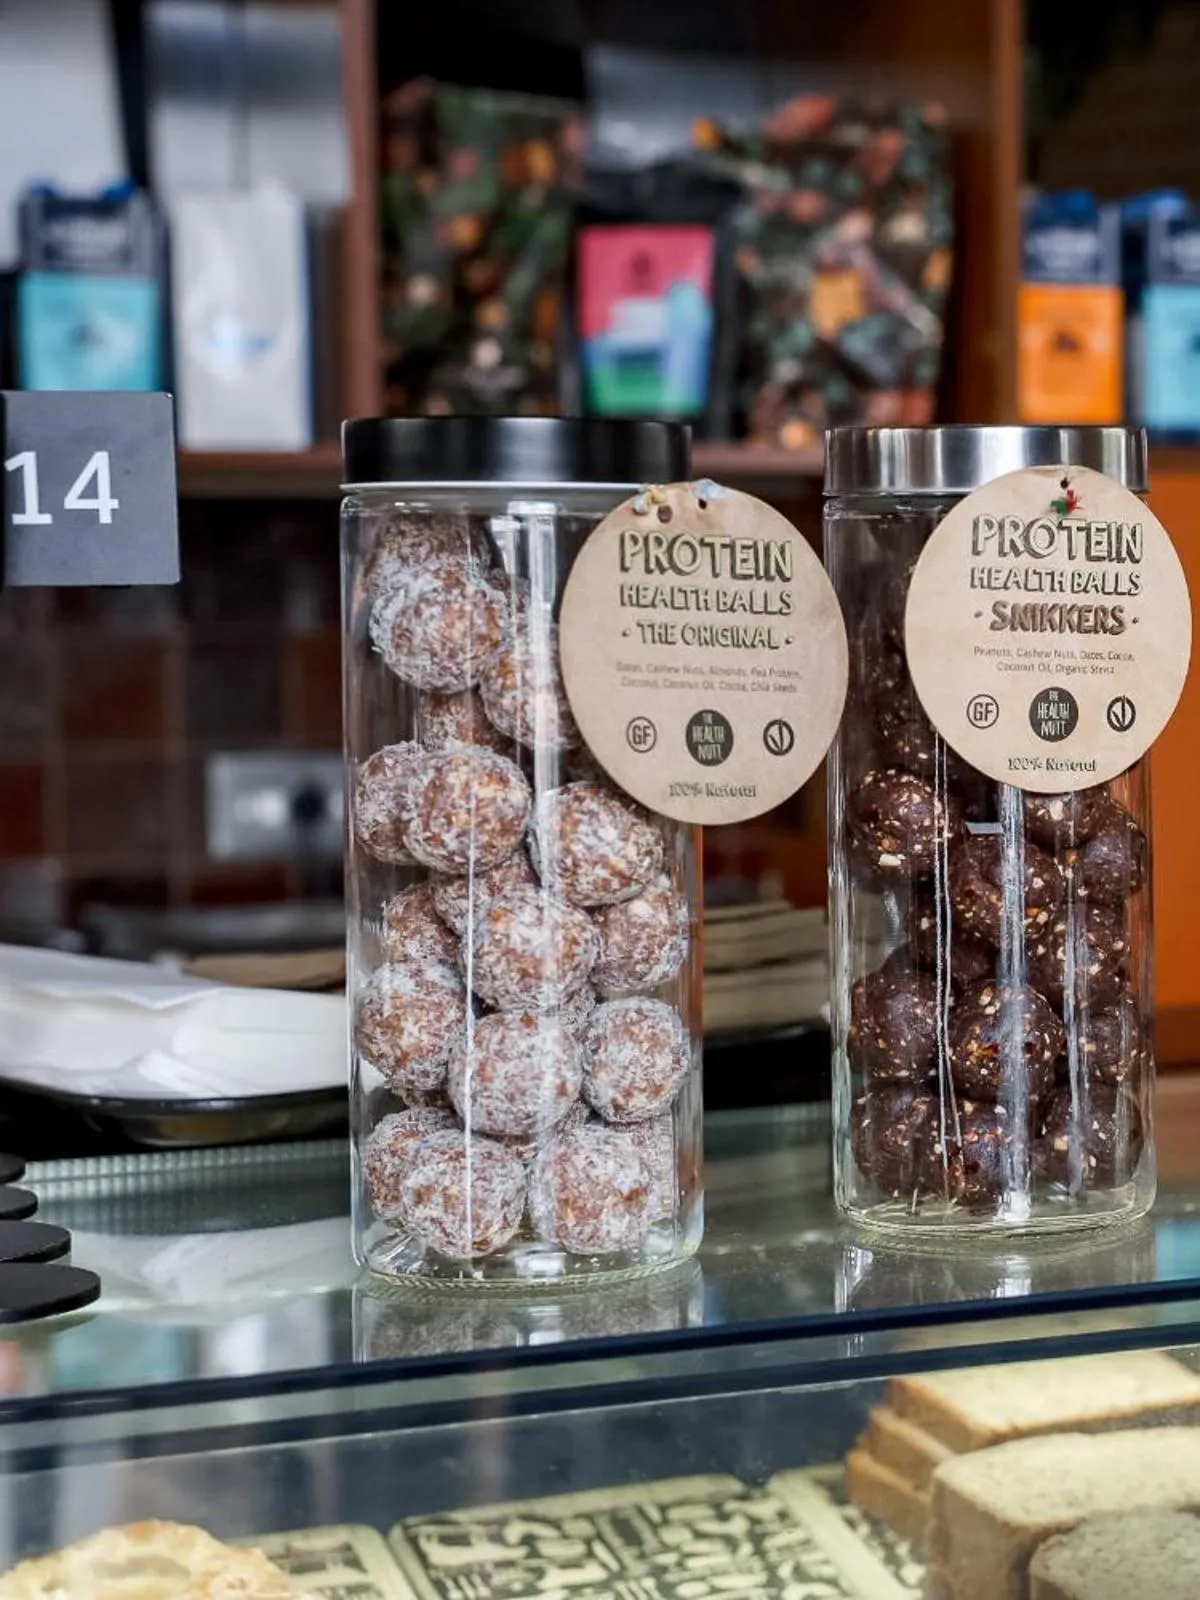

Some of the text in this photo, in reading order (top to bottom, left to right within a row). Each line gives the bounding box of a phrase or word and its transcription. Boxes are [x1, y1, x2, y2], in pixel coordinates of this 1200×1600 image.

[4, 451, 120, 526] 14
[972, 513, 1144, 564] PROTEIN
[620, 530, 793, 582] PROTEIN
[970, 566, 1142, 596] HEALTH BALLS
[620, 584, 794, 615] HEALTH BALLS
[989, 600, 1127, 636] SNIKKERS
[636, 620, 780, 650] THE ORIGINAL
[973, 702, 994, 721] GF
[1037, 701, 1070, 720] HEALTH
[632, 725, 652, 746] GF
[1007, 757, 1097, 772] 100% Natural
[705, 782, 756, 798] Natural
